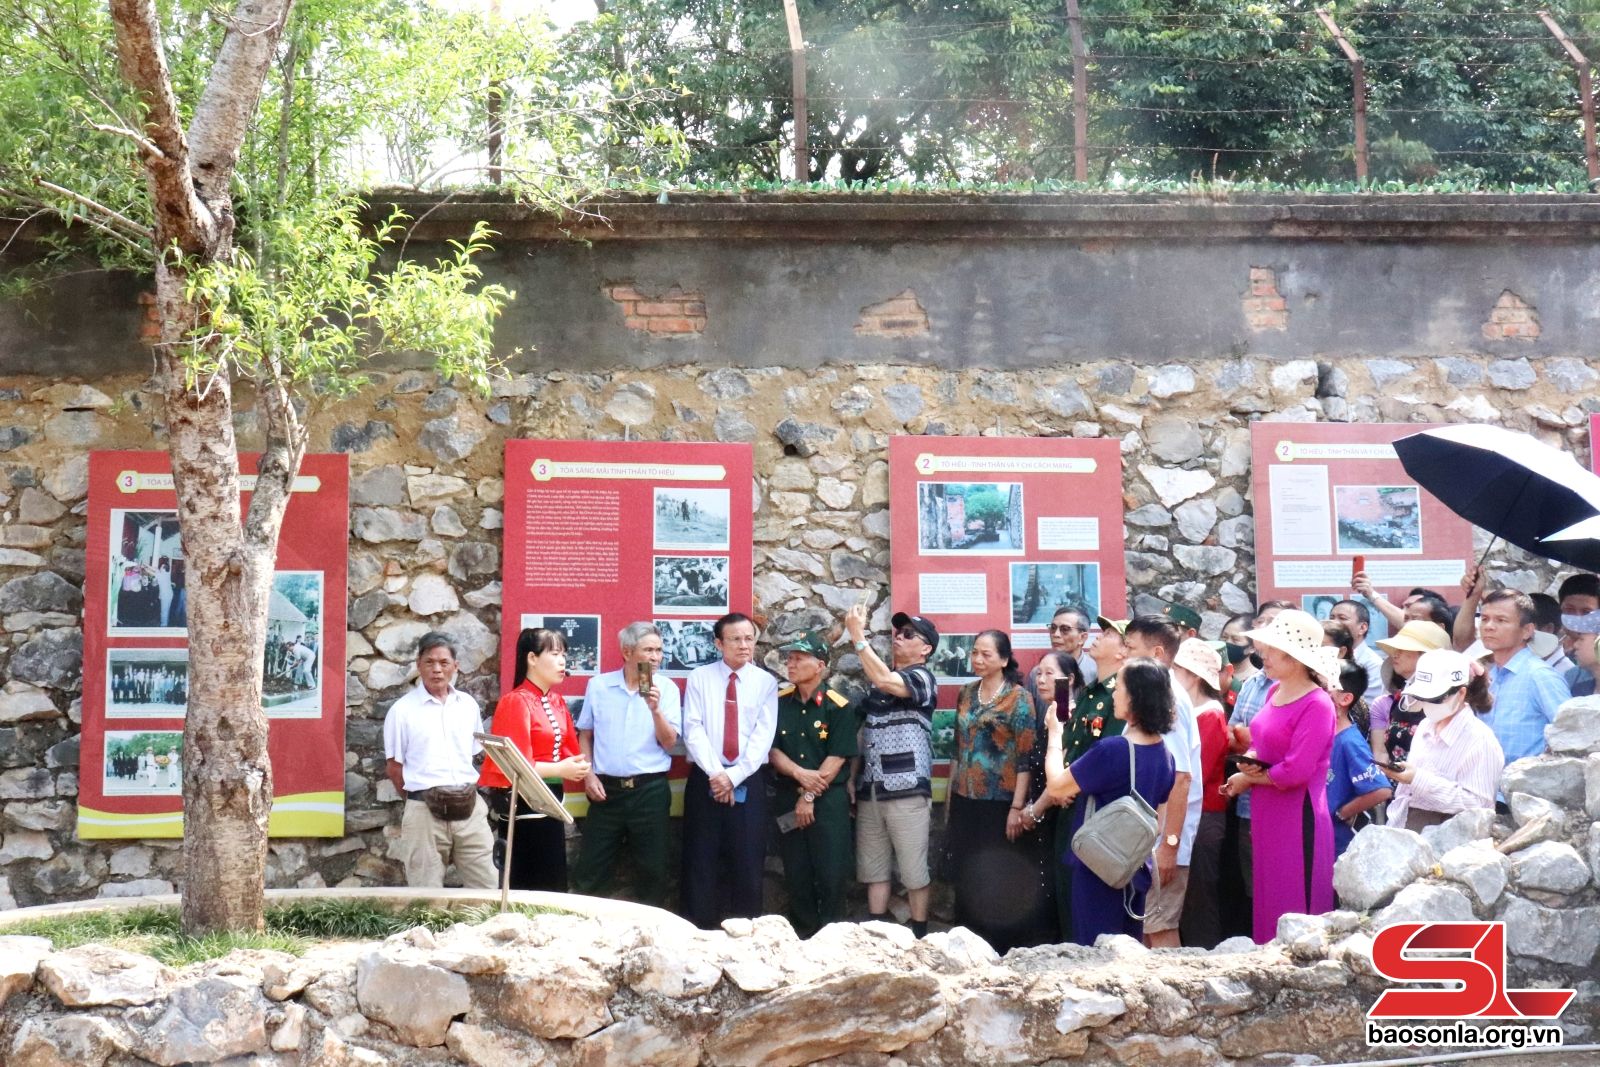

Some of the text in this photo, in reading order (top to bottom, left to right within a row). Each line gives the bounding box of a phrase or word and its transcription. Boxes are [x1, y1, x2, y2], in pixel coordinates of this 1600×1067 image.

[1282, 445, 1289, 455] 2
[922, 458, 930, 469] 2
[971, 460, 987, 469] TINH
[539, 464, 547, 475] 3
[125, 475, 133, 487] 3
